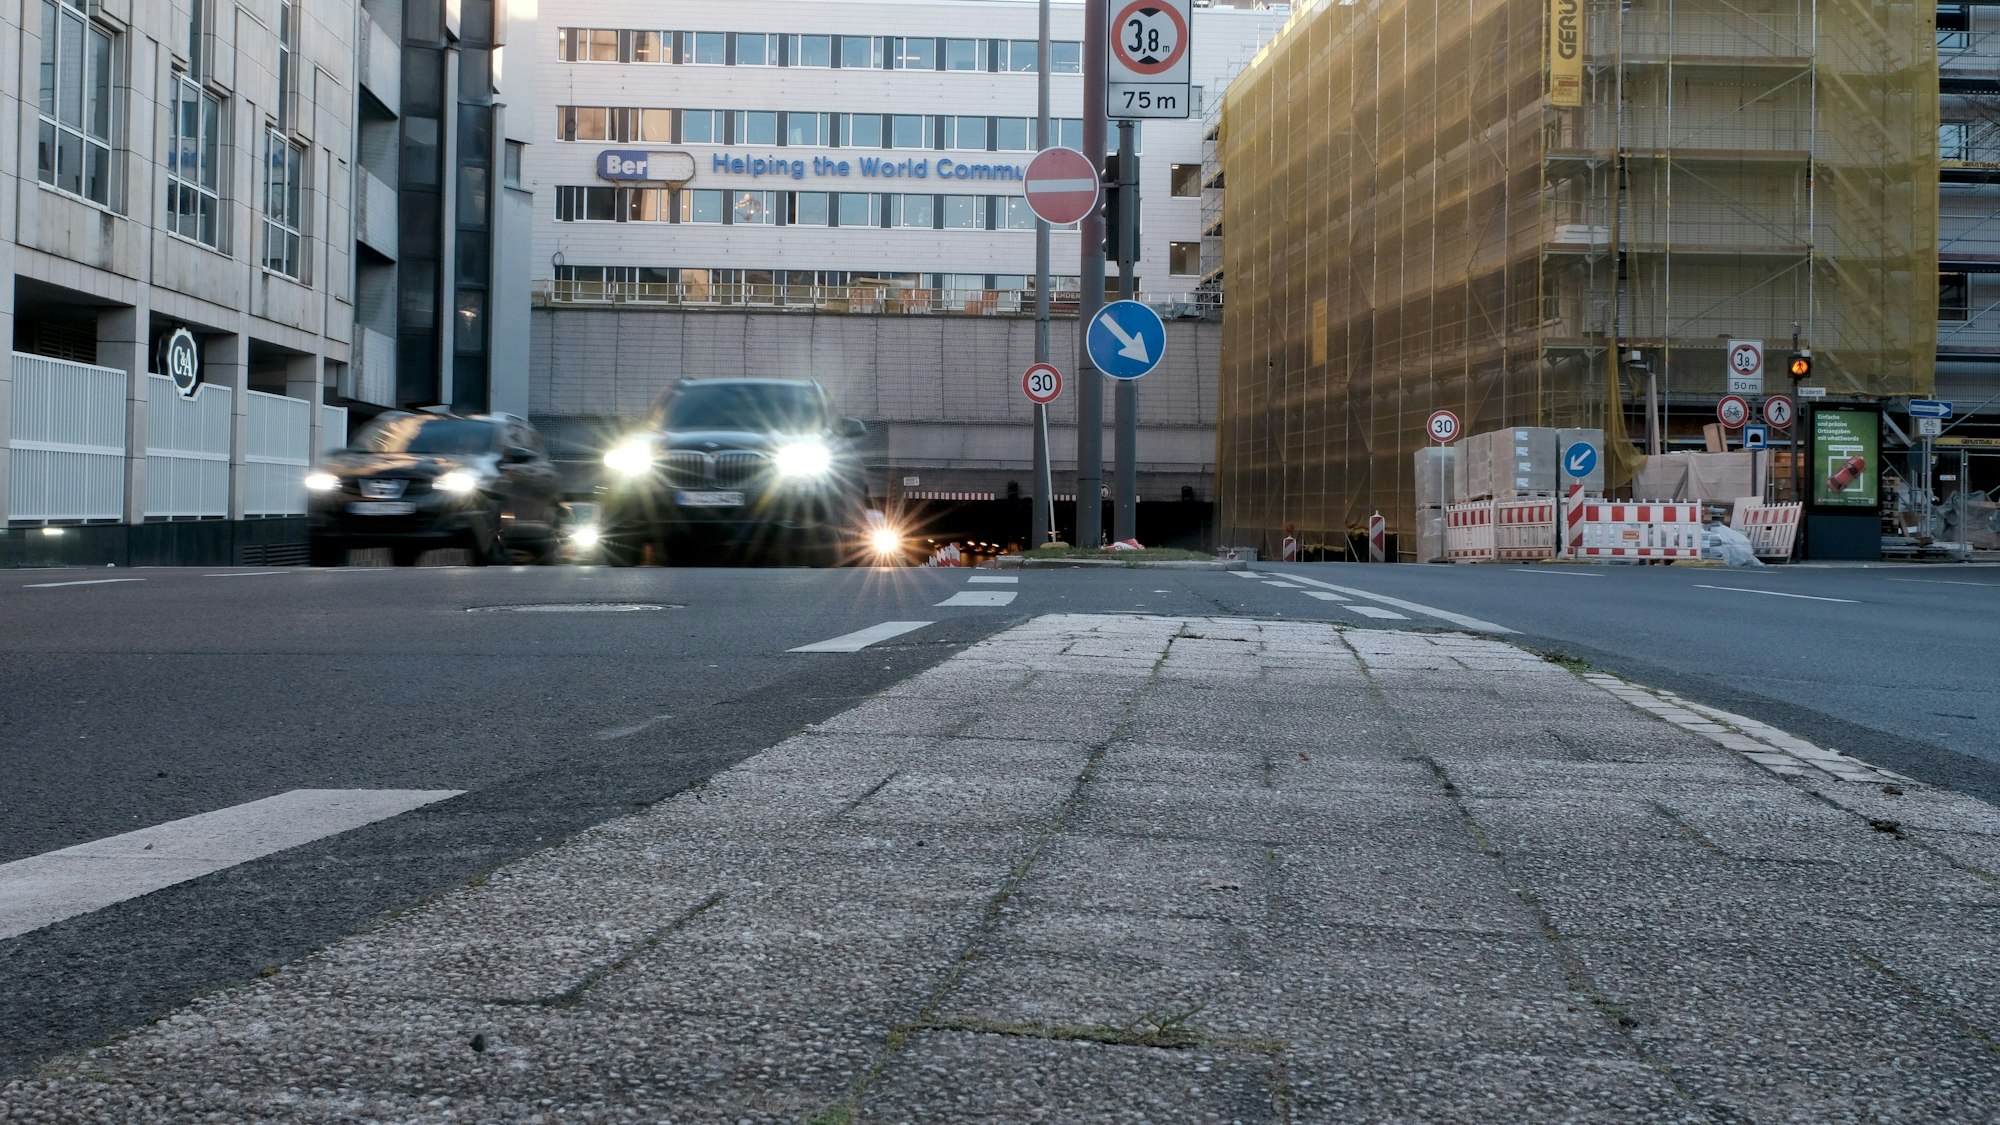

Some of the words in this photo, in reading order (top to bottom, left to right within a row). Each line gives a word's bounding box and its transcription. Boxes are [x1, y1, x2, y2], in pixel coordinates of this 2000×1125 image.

[1128, 19, 1159, 54] 3,8
[1123, 91, 1151, 109] 75
[1157, 96, 1176, 109] m
[606, 155, 647, 175] Ber
[712, 152, 804, 179] Helping
[813, 155, 850, 176] the
[859, 156, 928, 178] World
[173, 345, 193, 377] C&A
[1031, 374, 1053, 392] 30
[1734, 381, 1747, 390] 50
[1434, 419, 1453, 434] 30
